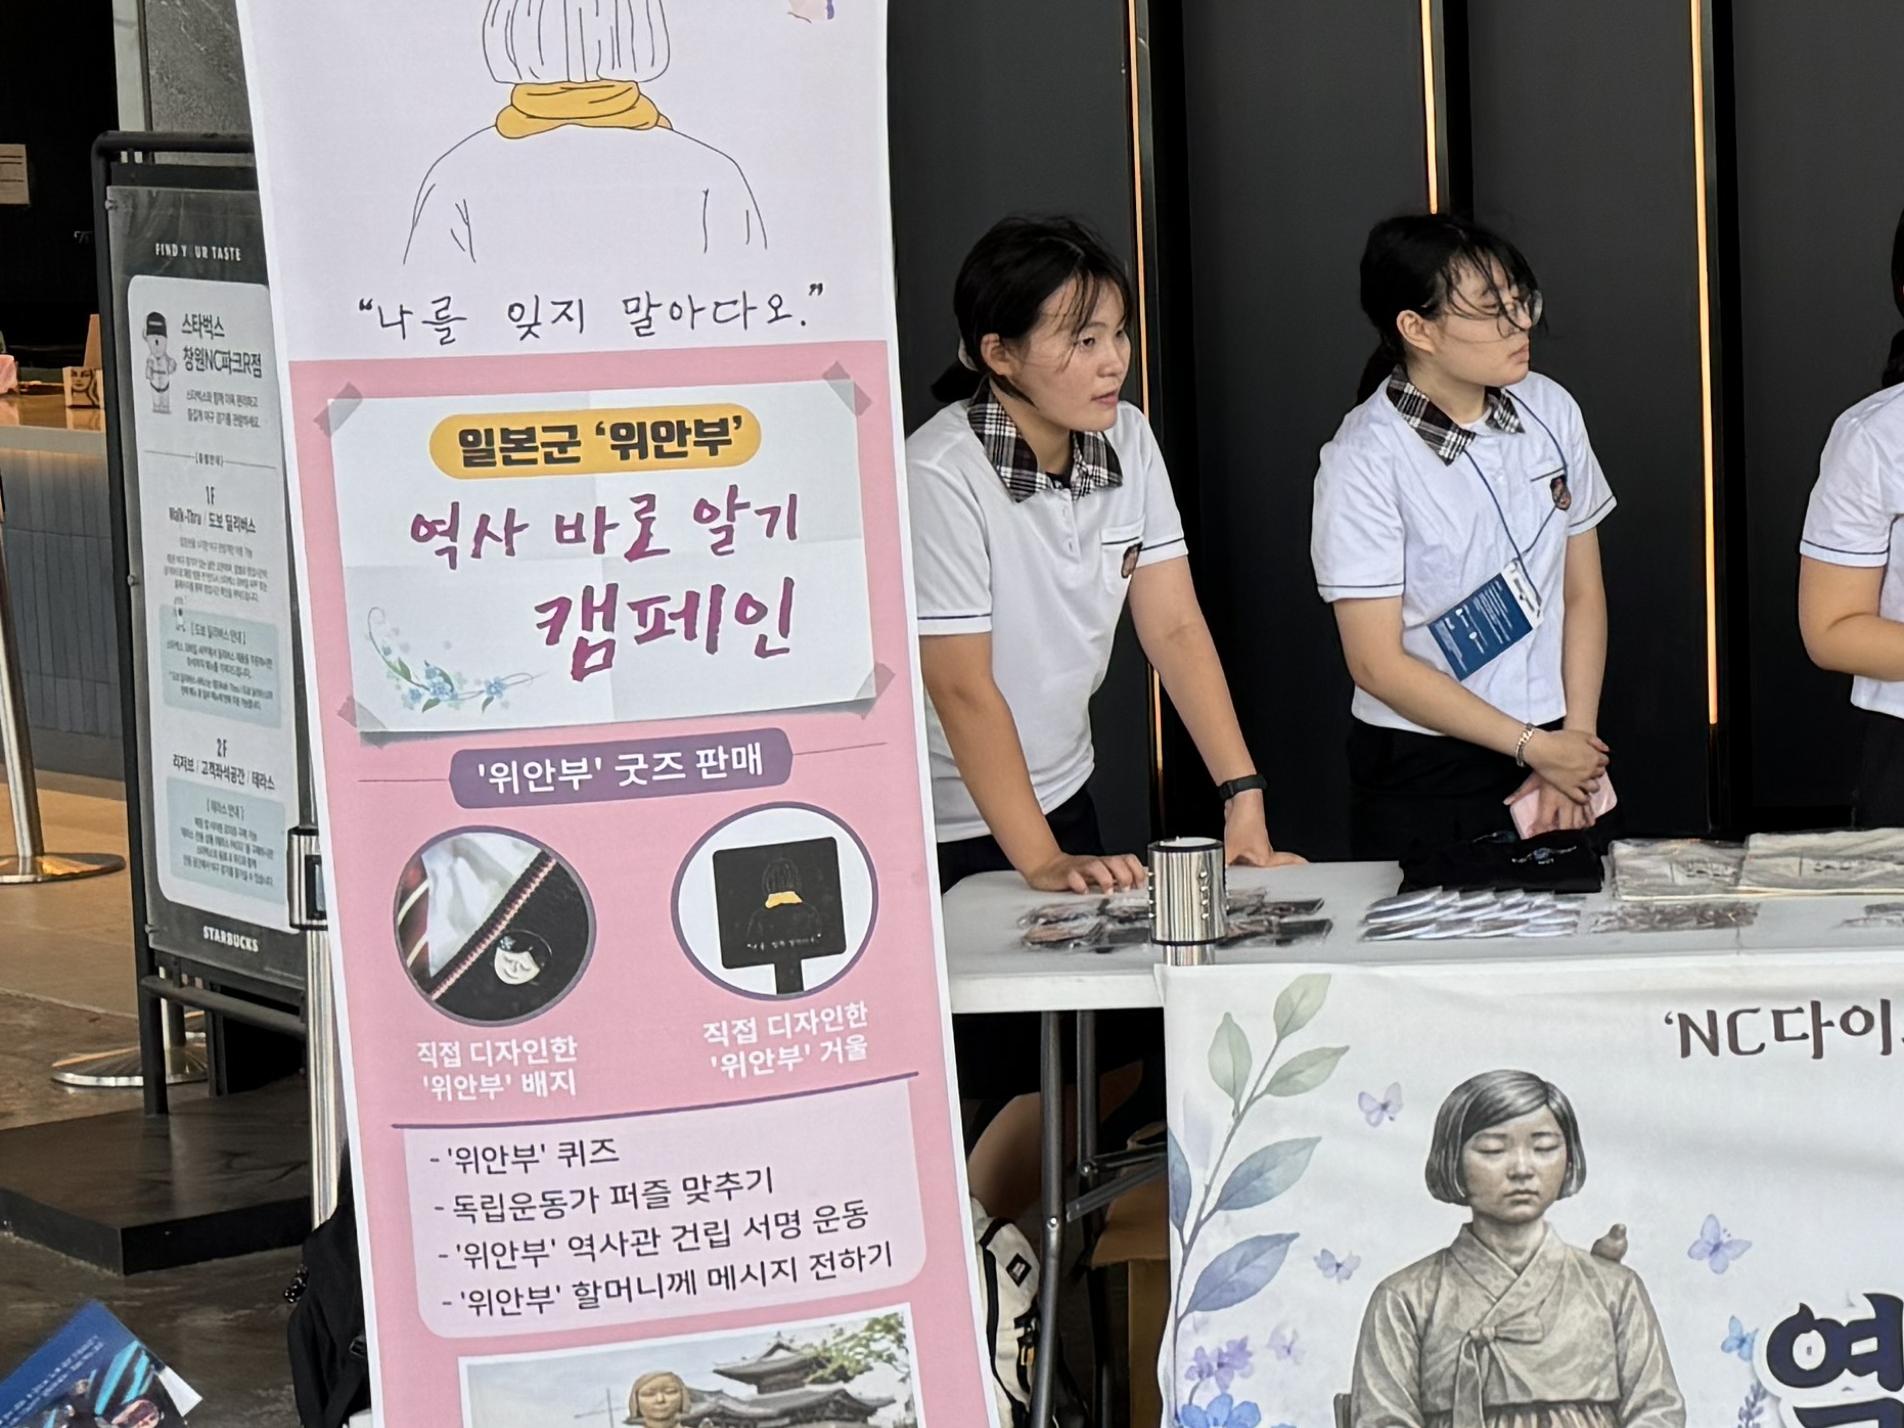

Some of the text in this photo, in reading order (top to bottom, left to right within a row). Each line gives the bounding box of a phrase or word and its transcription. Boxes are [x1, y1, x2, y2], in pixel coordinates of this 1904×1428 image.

[155, 242, 241, 262] FIND YUR TASTE
[181, 313, 225, 340] 스타벅스
[507, 294, 585, 341] 잊지
[182, 346, 263, 379] 창원NC파크R점
[458, 424, 582, 468] 일본군
[410, 484, 799, 570] 역사 바로 알기
[534, 576, 795, 682] 캠페인
[216, 738, 228, 758] 2F
[478, 741, 764, 795] '위안부' 굿즈 판매
[203, 925, 259, 953] STARBUCKS
[703, 1000, 868, 1048] 직접 디자인한
[416, 1035, 578, 1070] 직접 디자인한
[820, 1034, 868, 1065] 거울
[522, 1069, 577, 1097] 배지
[557, 1138, 621, 1169] 퀴즈
[452, 1166, 775, 1225] 독립운동가 퍼즐 맞추기
[567, 1228, 661, 1263] 역사관
[670, 1220, 731, 1254] 건립
[742, 1209, 802, 1244] 서명
[811, 1198, 870, 1235] 운동
[573, 1269, 698, 1311] 할머니께
[707, 1256, 799, 1293] 메시지
[808, 1240, 893, 1283] 전하기
